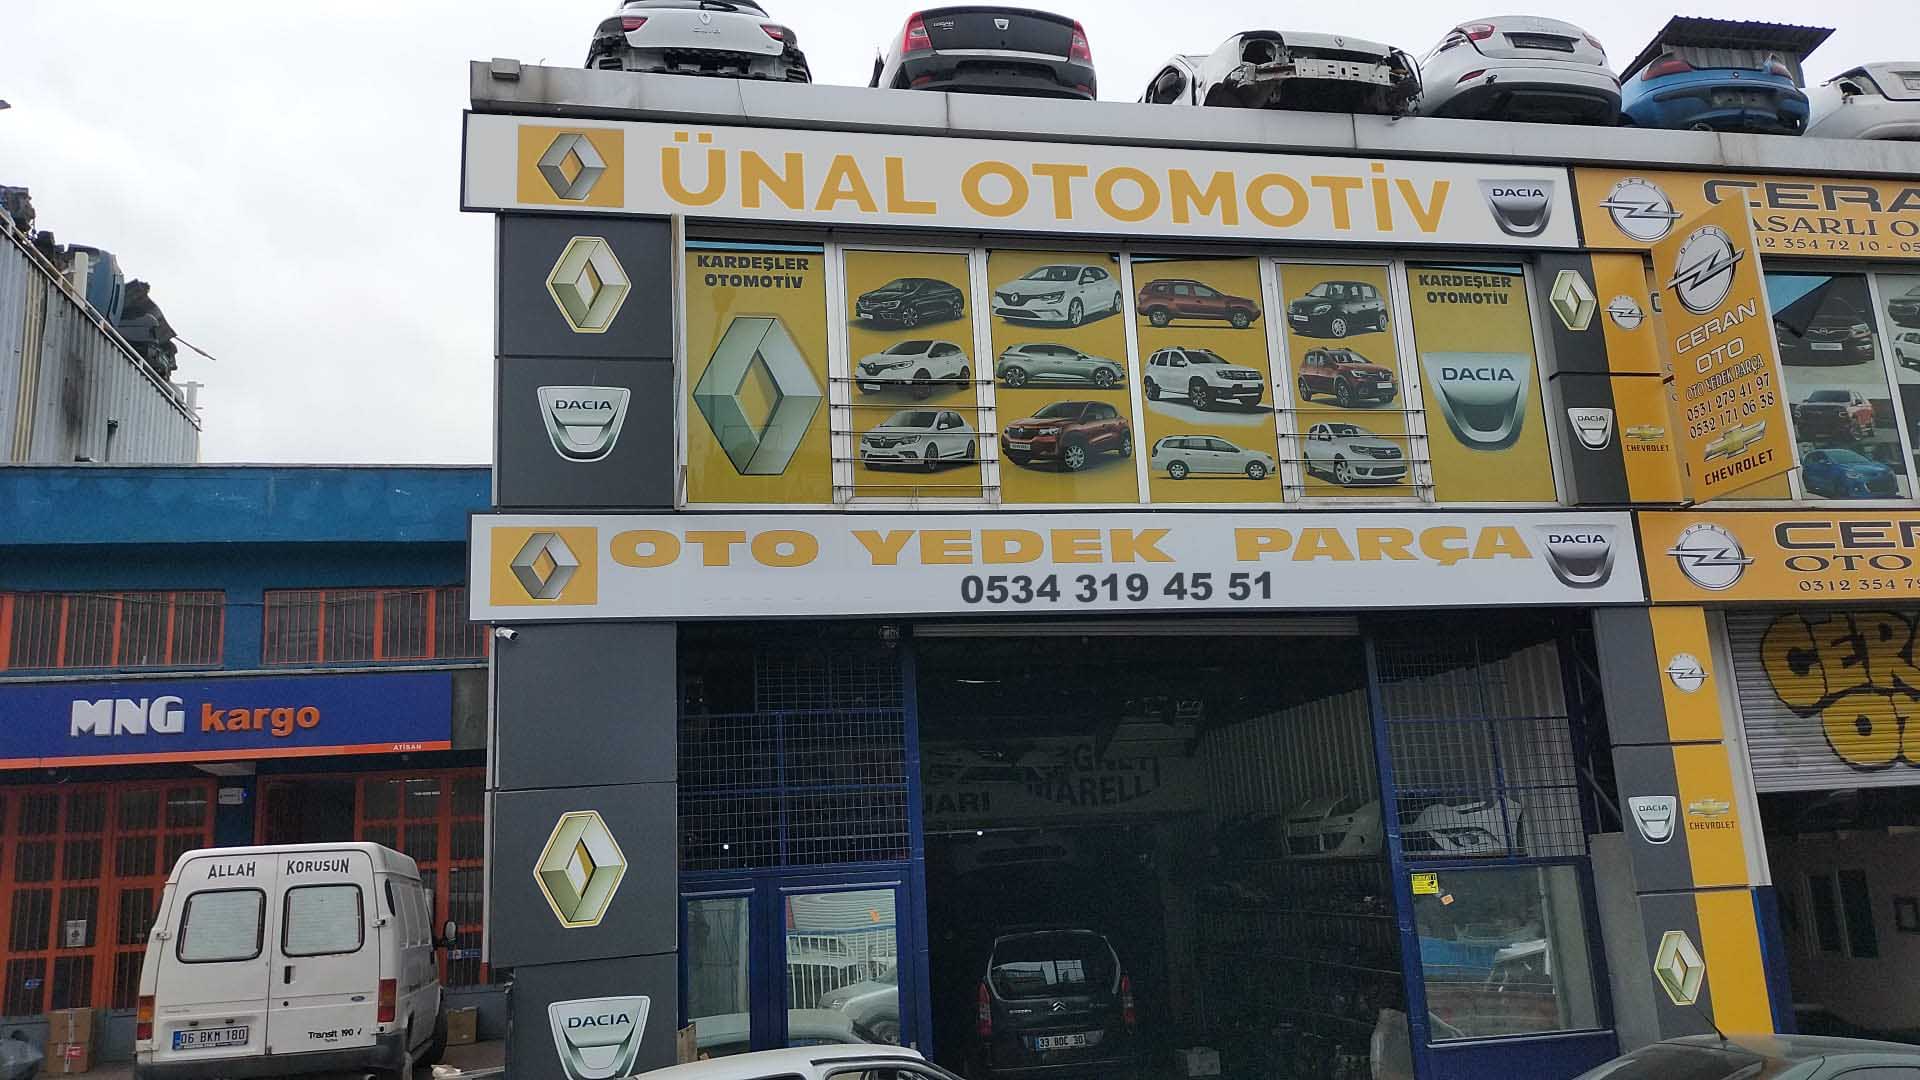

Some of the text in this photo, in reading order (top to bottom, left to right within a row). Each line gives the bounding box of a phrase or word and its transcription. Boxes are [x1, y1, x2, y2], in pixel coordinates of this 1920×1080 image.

[661, 132, 1450, 233] ÜNAL OTOMOTİV
[1492, 185, 1545, 200] DACIA
[1784, 238, 1818, 249] 354
[1826, 239, 1849, 250] 72
[1859, 241, 1879, 252] 10
[697, 255, 809, 271] KARDEŞLER
[704, 273, 803, 289] OTOMOTİV
[1419, 273, 1512, 289] KARDEŞLER
[1426, 289, 1508, 305] OTOMOTİV
[1676, 298, 1758, 354] CERAN
[1696, 337, 1744, 374] OTO
[1442, 366, 1515, 381] DACIA
[1686, 381, 1704, 401] OTO
[1704, 367, 1735, 392] YEDEK
[1734, 354, 1765, 379] PARÇA
[555, 399, 612, 410] DACIA
[1687, 373, 1769, 421] 0531 279 41 97
[1689, 391, 1774, 439] 0532 171 06 38
[1626, 444, 1669, 453] CHEVROLET
[1704, 449, 1774, 486] CHEVROLET
[609, 526, 1534, 568] OTO YEDEK PARÇA
[1548, 533, 1607, 545] DACIA
[1785, 554, 1912, 572] OTO
[960, 571, 1273, 604] 0534 319 45 51
[1800, 579, 1850, 591] 0312
[1859, 579, 1895, 590] 354
[70, 695, 321, 736] MNG kargo
[1638, 804, 1668, 813] DACIA
[1689, 820, 1735, 830] CHEVROLET
[207, 857, 350, 879] ALLAH KORUSUN
[567, 1013, 630, 1029] DACIA
[181, 1032, 194, 1044] 06
[200, 1031, 220, 1043] BKM
[308, 1030, 337, 1040] Transit
